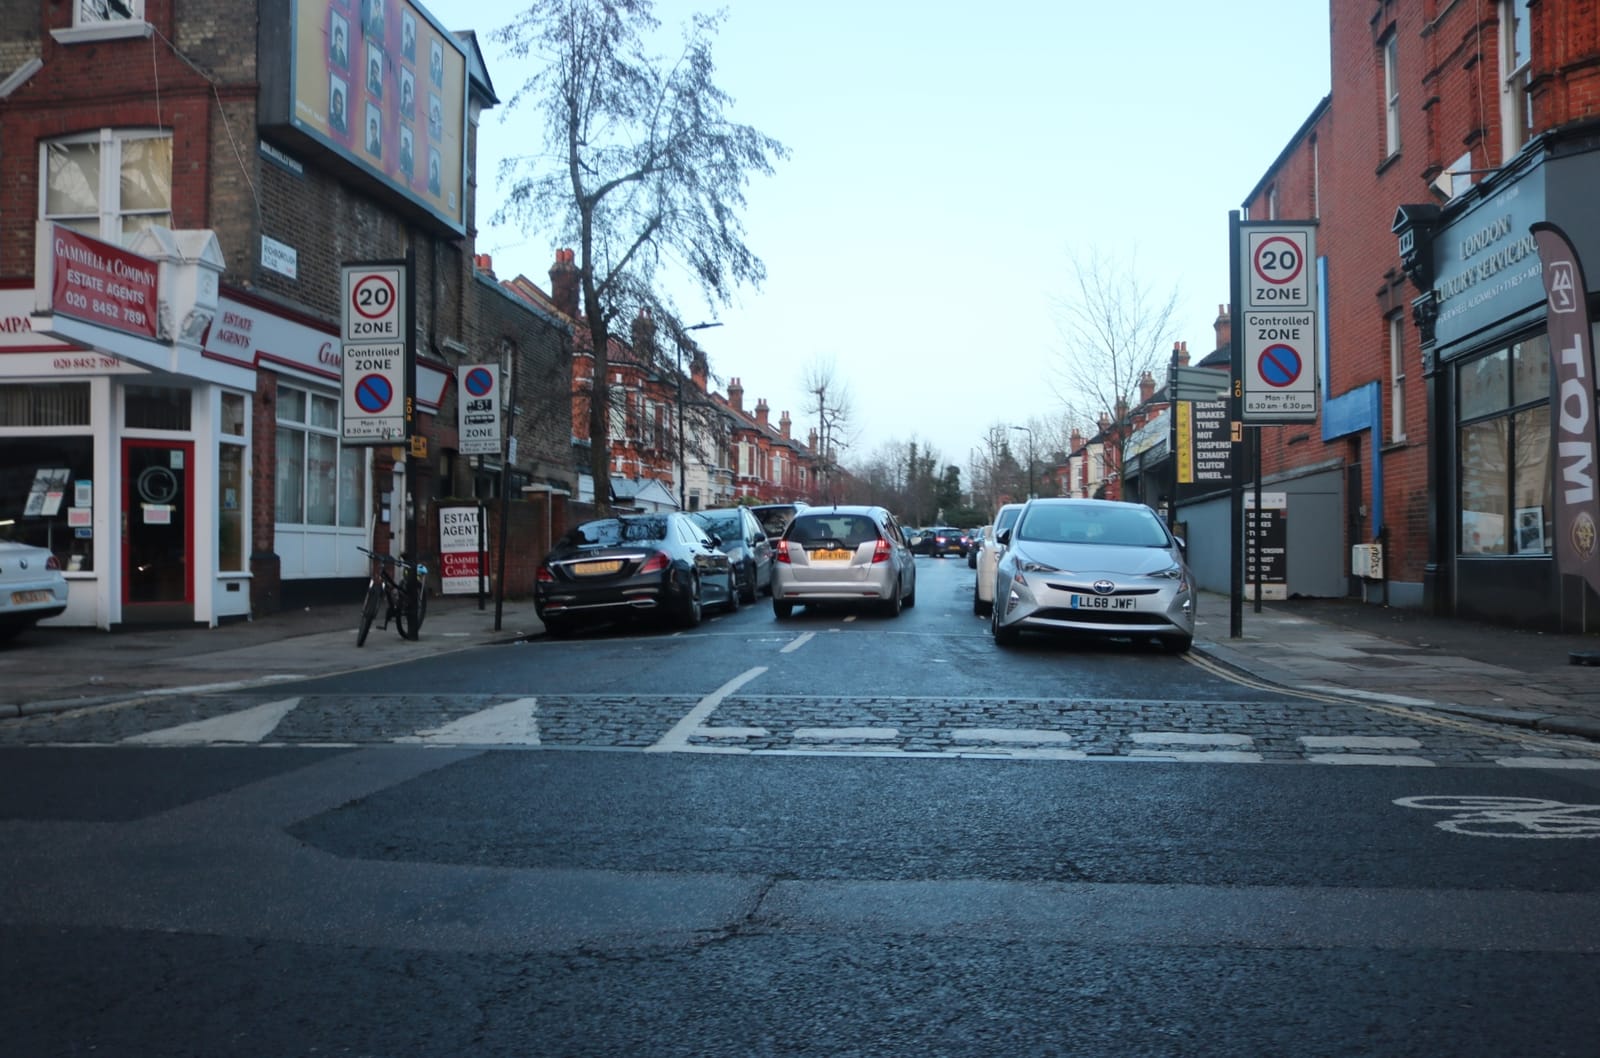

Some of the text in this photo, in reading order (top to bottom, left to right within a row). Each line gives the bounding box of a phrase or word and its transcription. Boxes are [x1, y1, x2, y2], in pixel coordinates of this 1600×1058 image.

[1460, 214, 1511, 260] LONDON
[56, 239, 155, 287] GAMMELL & COMPANY
[1262, 251, 1295, 270] 20
[67, 269, 144, 304] ESTATE AGENTS
[1436, 268, 1475, 304] LUXURY
[1468, 285, 1499, 309] ALIGNMENT
[1505, 273, 1522, 290] TYRES
[359, 288, 389, 306] 20
[1256, 288, 1301, 300] ZONE
[66, 291, 146, 326] 020 8452 7891
[223, 311, 253, 331] ESTATE
[1249, 316, 1309, 326] Controlled
[354, 321, 393, 334] ZONE
[217, 328, 251, 349] AGENTS
[1258, 329, 1300, 340] ZONE
[347, 346, 400, 358] Controlled
[53, 357, 120, 369] 020 8452 7891
[355, 359, 392, 370] ZONE
[1196, 401, 1226, 409] SERVICE
[1196, 411, 1225, 419] BRAKES
[1196, 421, 1220, 429] TYRES
[466, 429, 493, 438] ZONE
[1197, 451, 1229, 459] EXHAUST
[1198, 471, 1222, 479] WHEEL
[444, 512, 479, 524] ESTAT
[443, 525, 479, 536] AGENT
[444, 566, 479, 576] COMPAN
[1079, 597, 1133, 609] LL68 JWF
